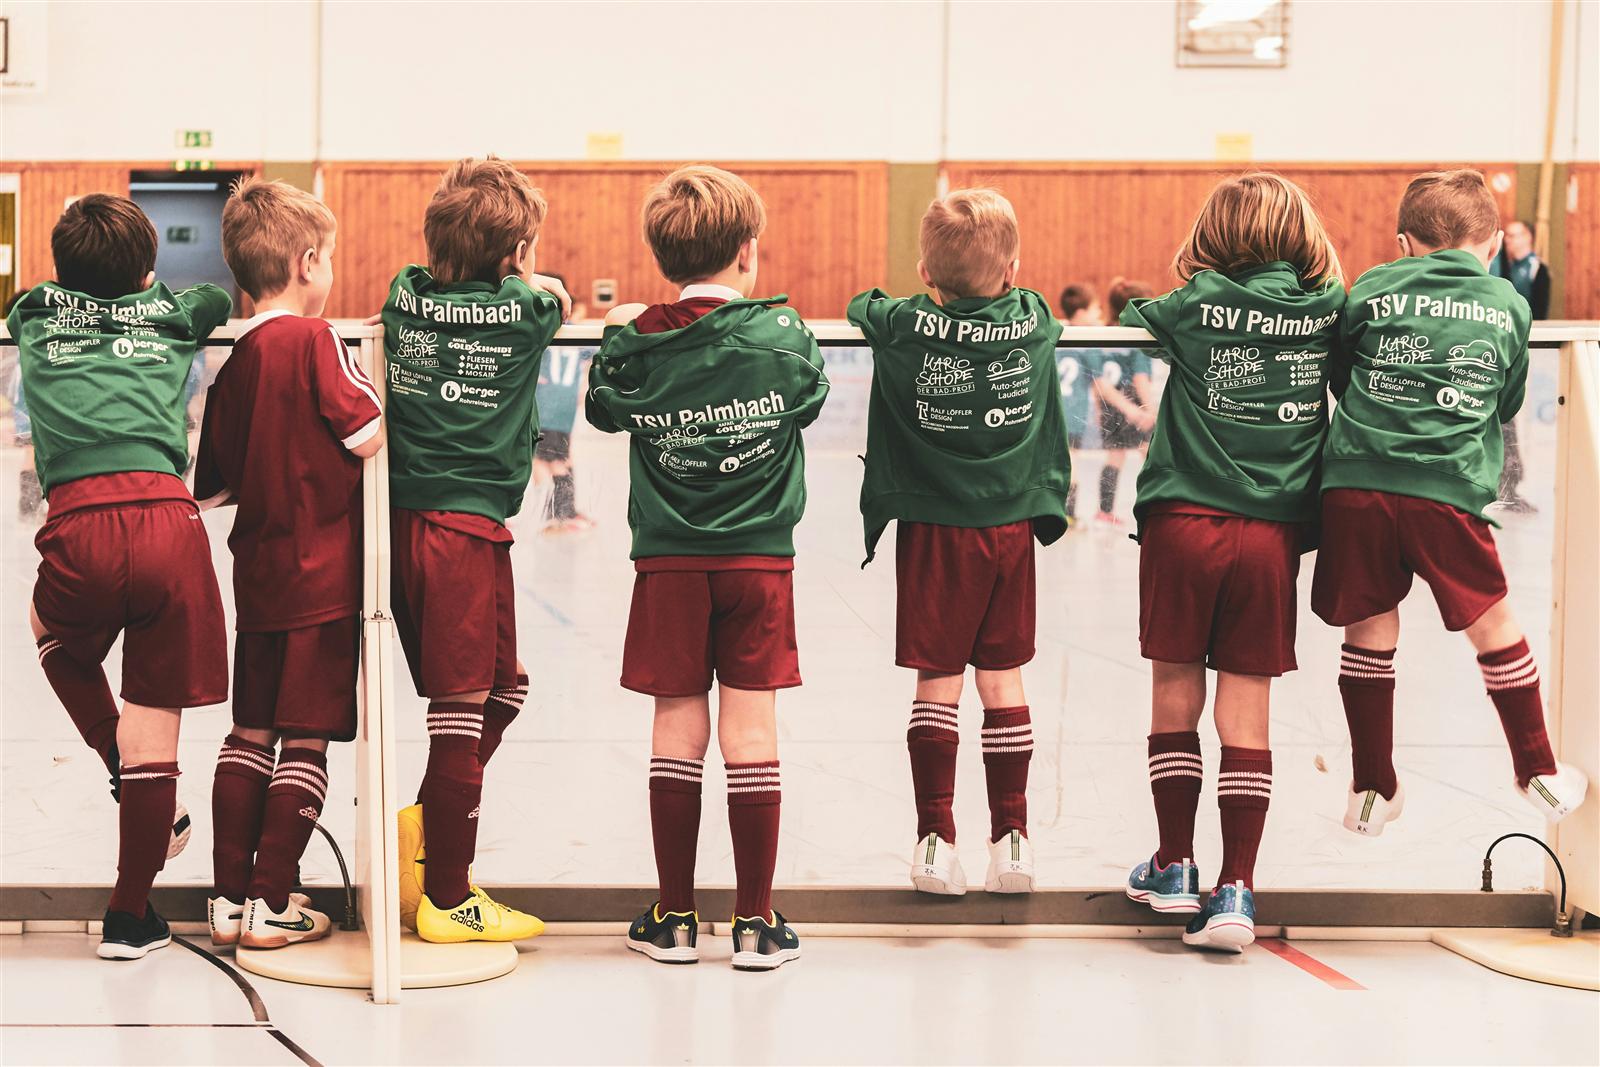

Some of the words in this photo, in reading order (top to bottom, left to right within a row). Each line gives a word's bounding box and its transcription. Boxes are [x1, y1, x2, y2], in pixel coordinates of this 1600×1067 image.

[395, 285, 417, 315] TSV
[421, 299, 521, 324] Palmbach
[1200, 303, 1241, 330] TSV
[1246, 309, 1338, 336] Palmbach
[1366, 293, 1409, 321] TSV
[1414, 294, 1513, 334] Palmbach
[914, 309, 952, 339] TSV
[957, 309, 1038, 343] Palmbach
[466, 363, 498, 371] PLATTEN
[467, 355, 496, 364] FLIESEN
[551, 348, 579, 386] 17
[465, 370, 496, 378] MOSAIK
[1382, 375, 1397, 383] RALF
[1448, 364, 1492, 383] Auto-Service
[462, 383, 500, 397] berger
[933, 384, 975, 394] BAD-PROFI
[1223, 376, 1266, 388] BAD-PROFI
[1380, 382, 1404, 391] DESIGN
[1221, 402, 1245, 411] DESIGN
[1460, 390, 1485, 408] berger
[630, 413, 672, 428] TSV
[679, 390, 785, 425] Palmbach
[930, 413, 953, 422] DESIGN
[739, 438, 771, 460] berger
[450, 911, 484, 933] adidas
